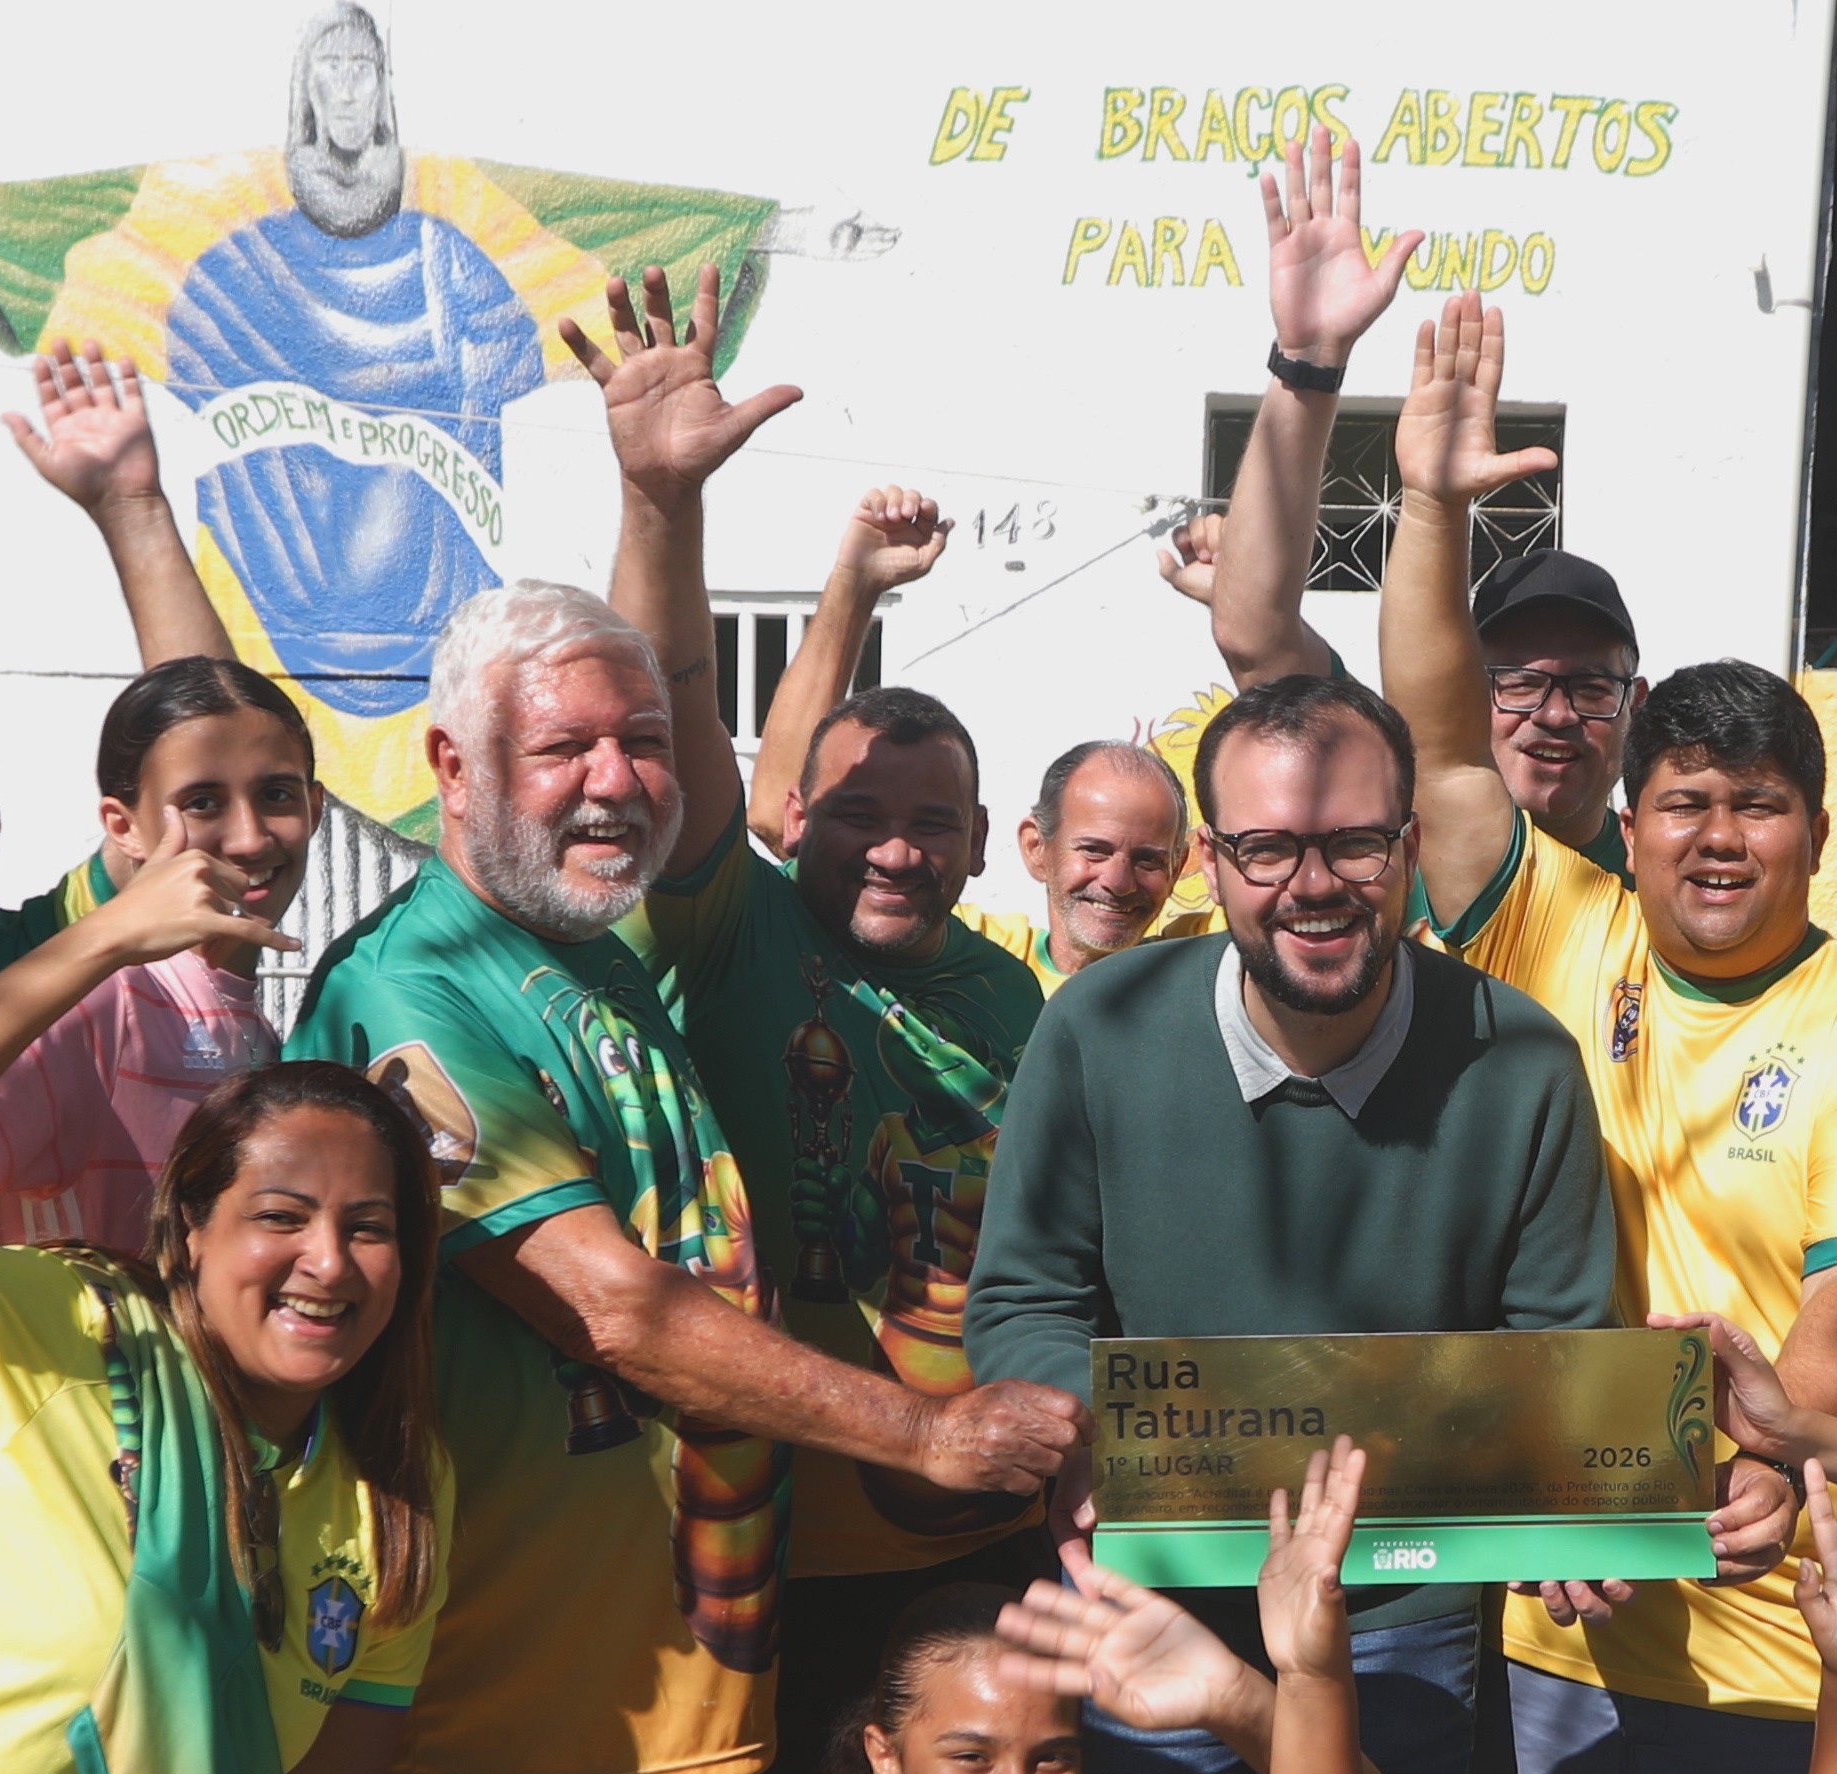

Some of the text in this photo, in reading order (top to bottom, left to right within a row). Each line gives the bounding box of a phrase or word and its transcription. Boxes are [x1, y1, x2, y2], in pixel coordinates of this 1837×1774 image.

[929, 84, 1679, 177] DE BRAÇOS ABERTOS
[1062, 216, 1244, 287] PARA
[213, 391, 337, 449] ORDEM
[972, 499, 1057, 549] 148
[1727, 1146, 1777, 1164] BRASIL
[1107, 1353, 1200, 1391] Rua
[1106, 1401, 1326, 1439] Taturana
[1139, 1455, 1235, 1477] LUGAR
[1583, 1447, 1652, 1468] 2026
[1566, 1480, 1630, 1493] Prefeitura
[1633, 1480, 1651, 1492] do
[1654, 1479, 1676, 1492] Rio
[1561, 1495, 1579, 1507] do
[1582, 1495, 1629, 1509] espaço
[1394, 1548, 1438, 1569] RIO
